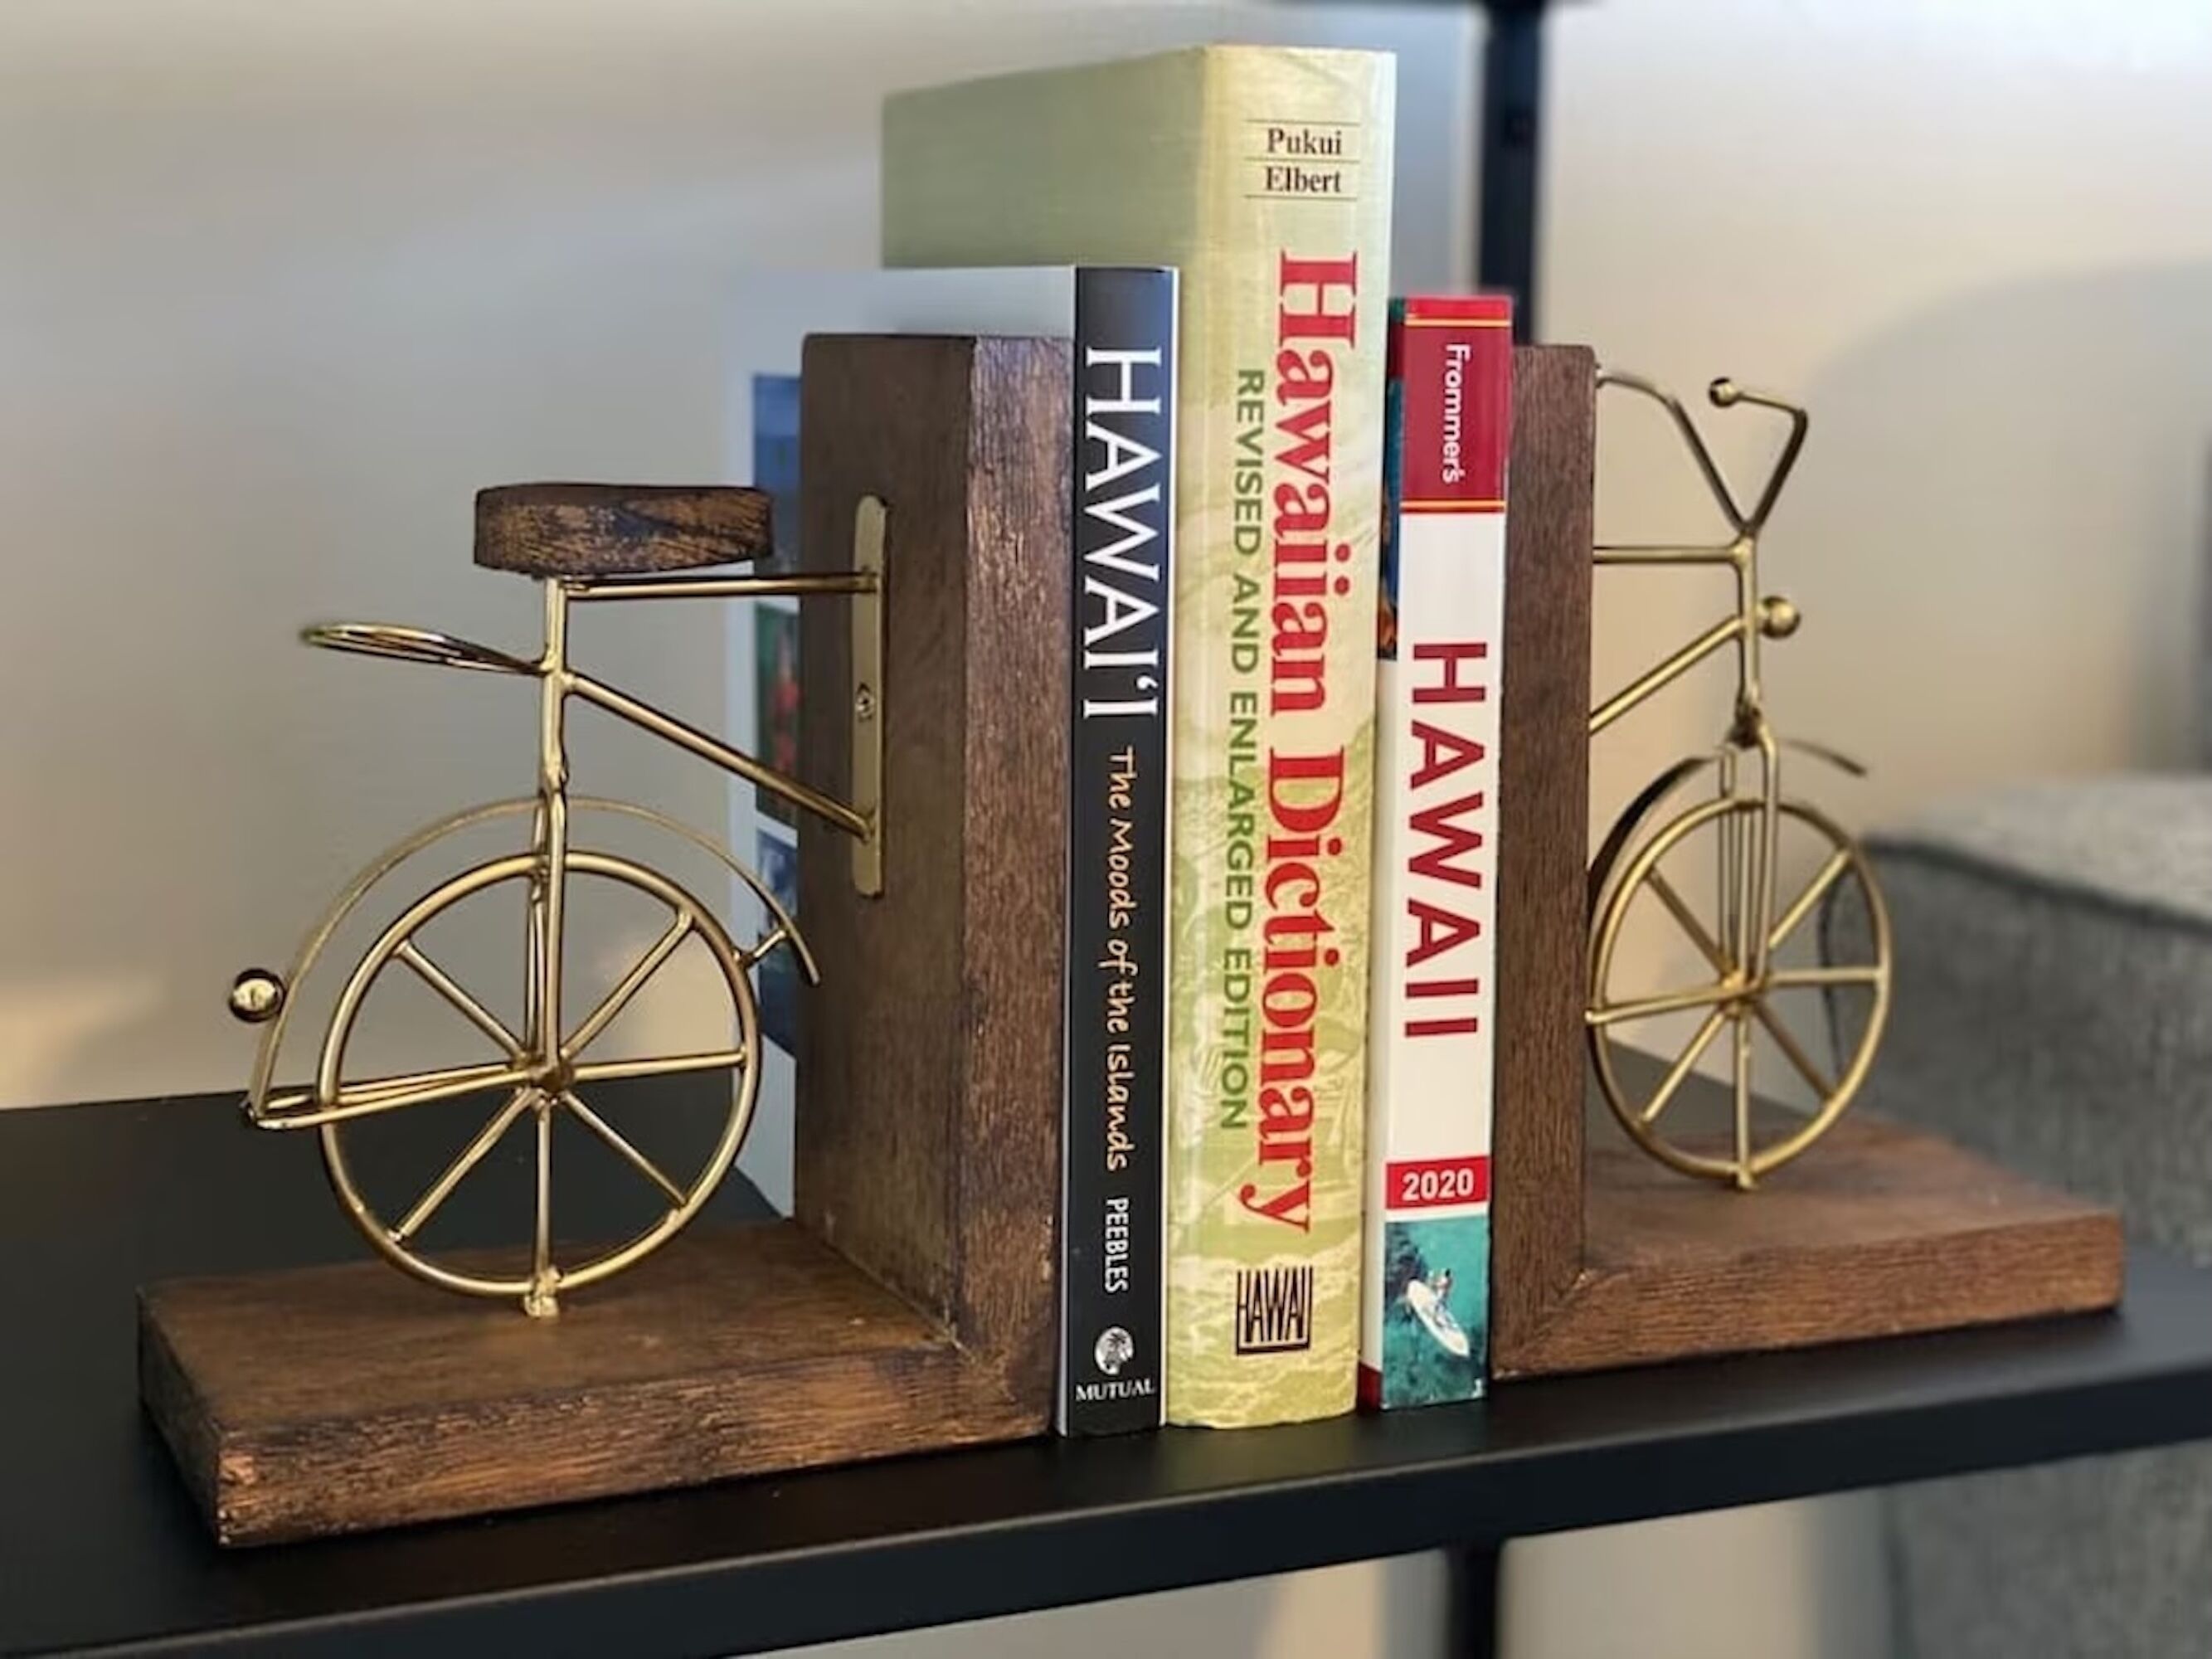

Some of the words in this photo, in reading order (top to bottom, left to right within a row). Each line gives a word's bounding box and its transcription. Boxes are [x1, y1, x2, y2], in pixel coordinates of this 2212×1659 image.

[1265, 166, 1341, 192] Elbert
[1267, 128, 1342, 155] Pukui
[1232, 370, 1265, 555] REVISED
[1270, 250, 1359, 716] Hawaiian
[1231, 574, 1261, 674] AND
[1107, 745, 1138, 811] The
[1224, 692, 1257, 930] ENLARGED
[1106, 818, 1138, 930] Moods
[1404, 642, 1488, 1038] HAWAII
[1098, 938, 1138, 976] of
[1106, 977, 1136, 1034] the
[1239, 747, 1345, 1233] Dictionary
[1220, 948, 1252, 1130] EDITION
[1106, 1044, 1135, 1171] Islands
[1402, 1169, 1474, 1201] 2020
[1104, 1197, 1130, 1294] PEEBLES
[1076, 1377, 1156, 1401] MUTUAL
